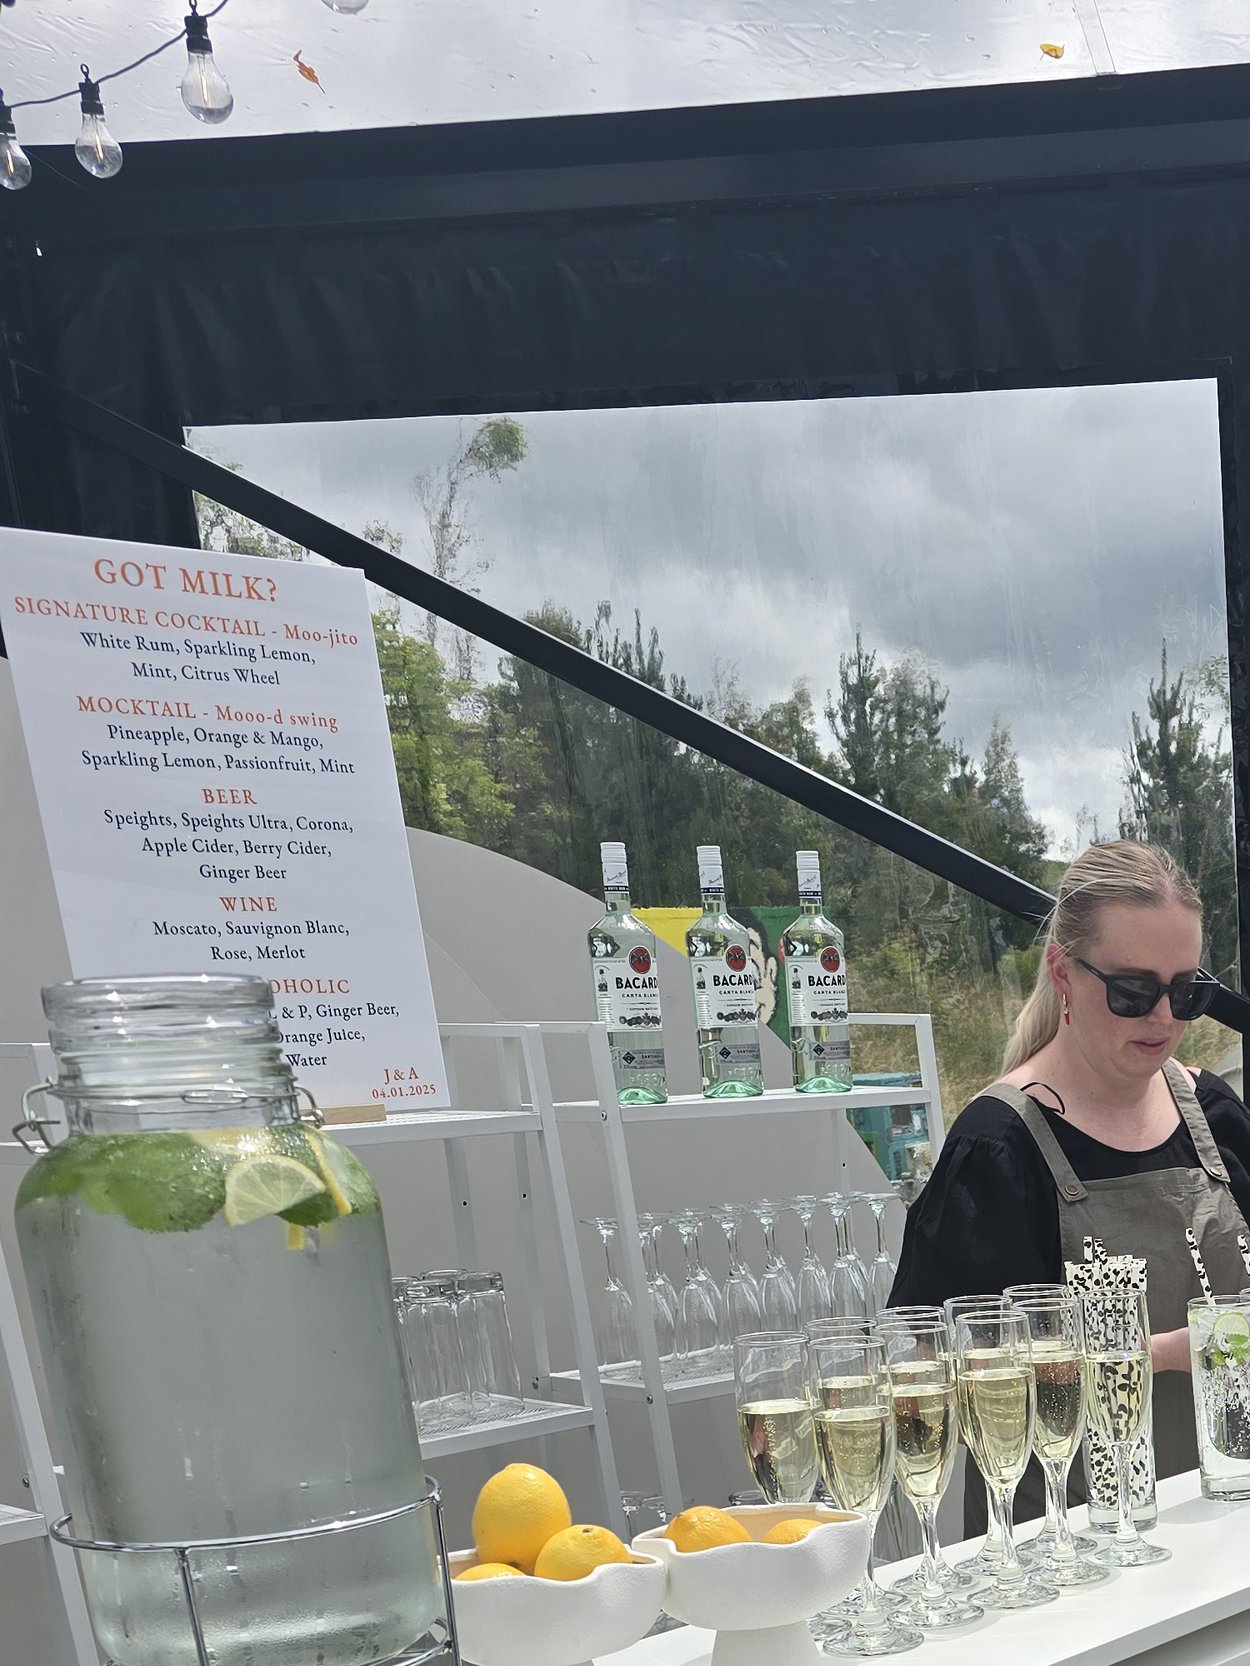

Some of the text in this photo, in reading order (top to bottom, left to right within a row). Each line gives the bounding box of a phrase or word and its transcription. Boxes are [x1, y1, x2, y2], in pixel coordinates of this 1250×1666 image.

[94, 558, 277, 602] GOT MILK?
[15, 596, 148, 626] SIGNATURE
[155, 611, 266, 637] COCKTAIL
[284, 624, 358, 648] Moo-jito
[80, 631, 316, 664] White Rum, Sparkling Lemon,
[132, 662, 280, 685] Mint, Citrus Wheel
[77, 695, 196, 719] MOCKTAIL
[215, 705, 283, 725] Mooo-d
[290, 714, 339, 733] swing
[107, 724, 323, 751] Pineapple, Orange & Mango,
[81, 750, 355, 775] Sparkling Lemon, Passionfruit, Mint
[202, 788, 258, 805] BEER
[104, 809, 353, 833] Speights, Speights Ultra, Corona,
[141, 837, 332, 859] Apple Cider, Berry Cider,
[199, 864, 286, 884] Ginger Beer
[219, 896, 278, 912] WINE
[152, 920, 349, 939] Moscato, Sauvignon Blanc,
[210, 945, 305, 961] Rose, Merlot
[270, 978, 350, 994] OHOLIC
[615, 977, 658, 989] BACARD
[713, 974, 754, 986] BACARD
[281, 1007, 295, 1019] &
[298, 1004, 313, 1020] P,
[316, 1004, 364, 1021] Ginger
[366, 1002, 400, 1017] Beer,
[327, 1028, 366, 1044] Juice,
[286, 1053, 328, 1068] Water
[383, 1066, 419, 1085] J & A
[371, 1083, 437, 1100] 04.01.2025
